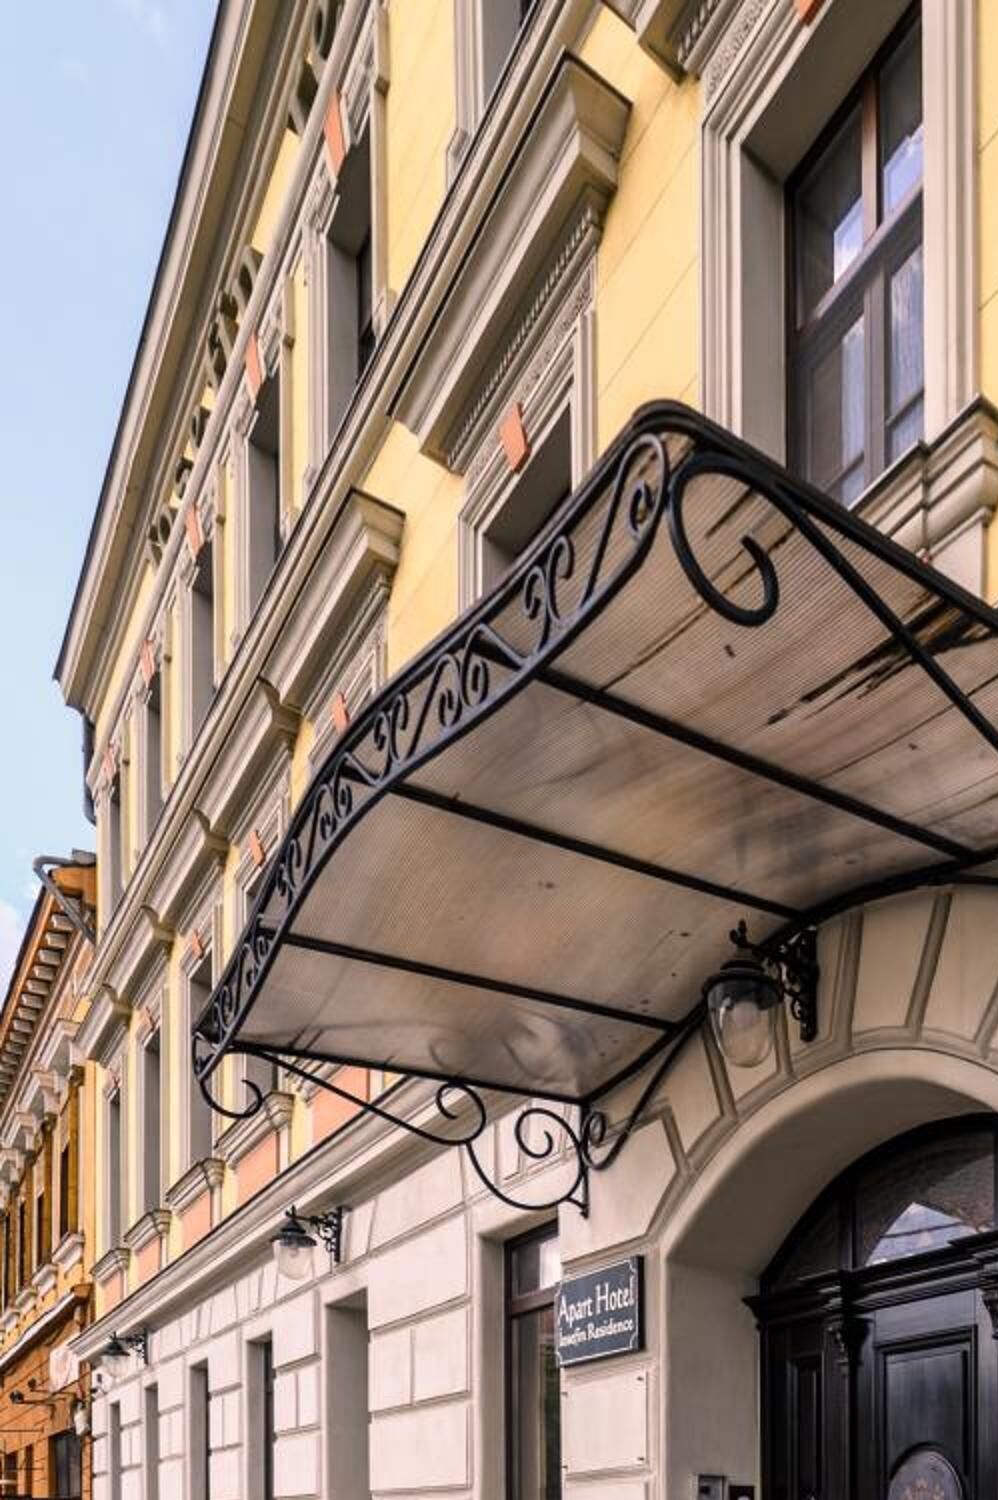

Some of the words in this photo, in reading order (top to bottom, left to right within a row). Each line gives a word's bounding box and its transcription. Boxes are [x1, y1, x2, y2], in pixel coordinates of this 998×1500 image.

[559, 1295, 593, 1328] Apart
[595, 1276, 634, 1315] Hotel
[587, 1319, 633, 1341] Residence
